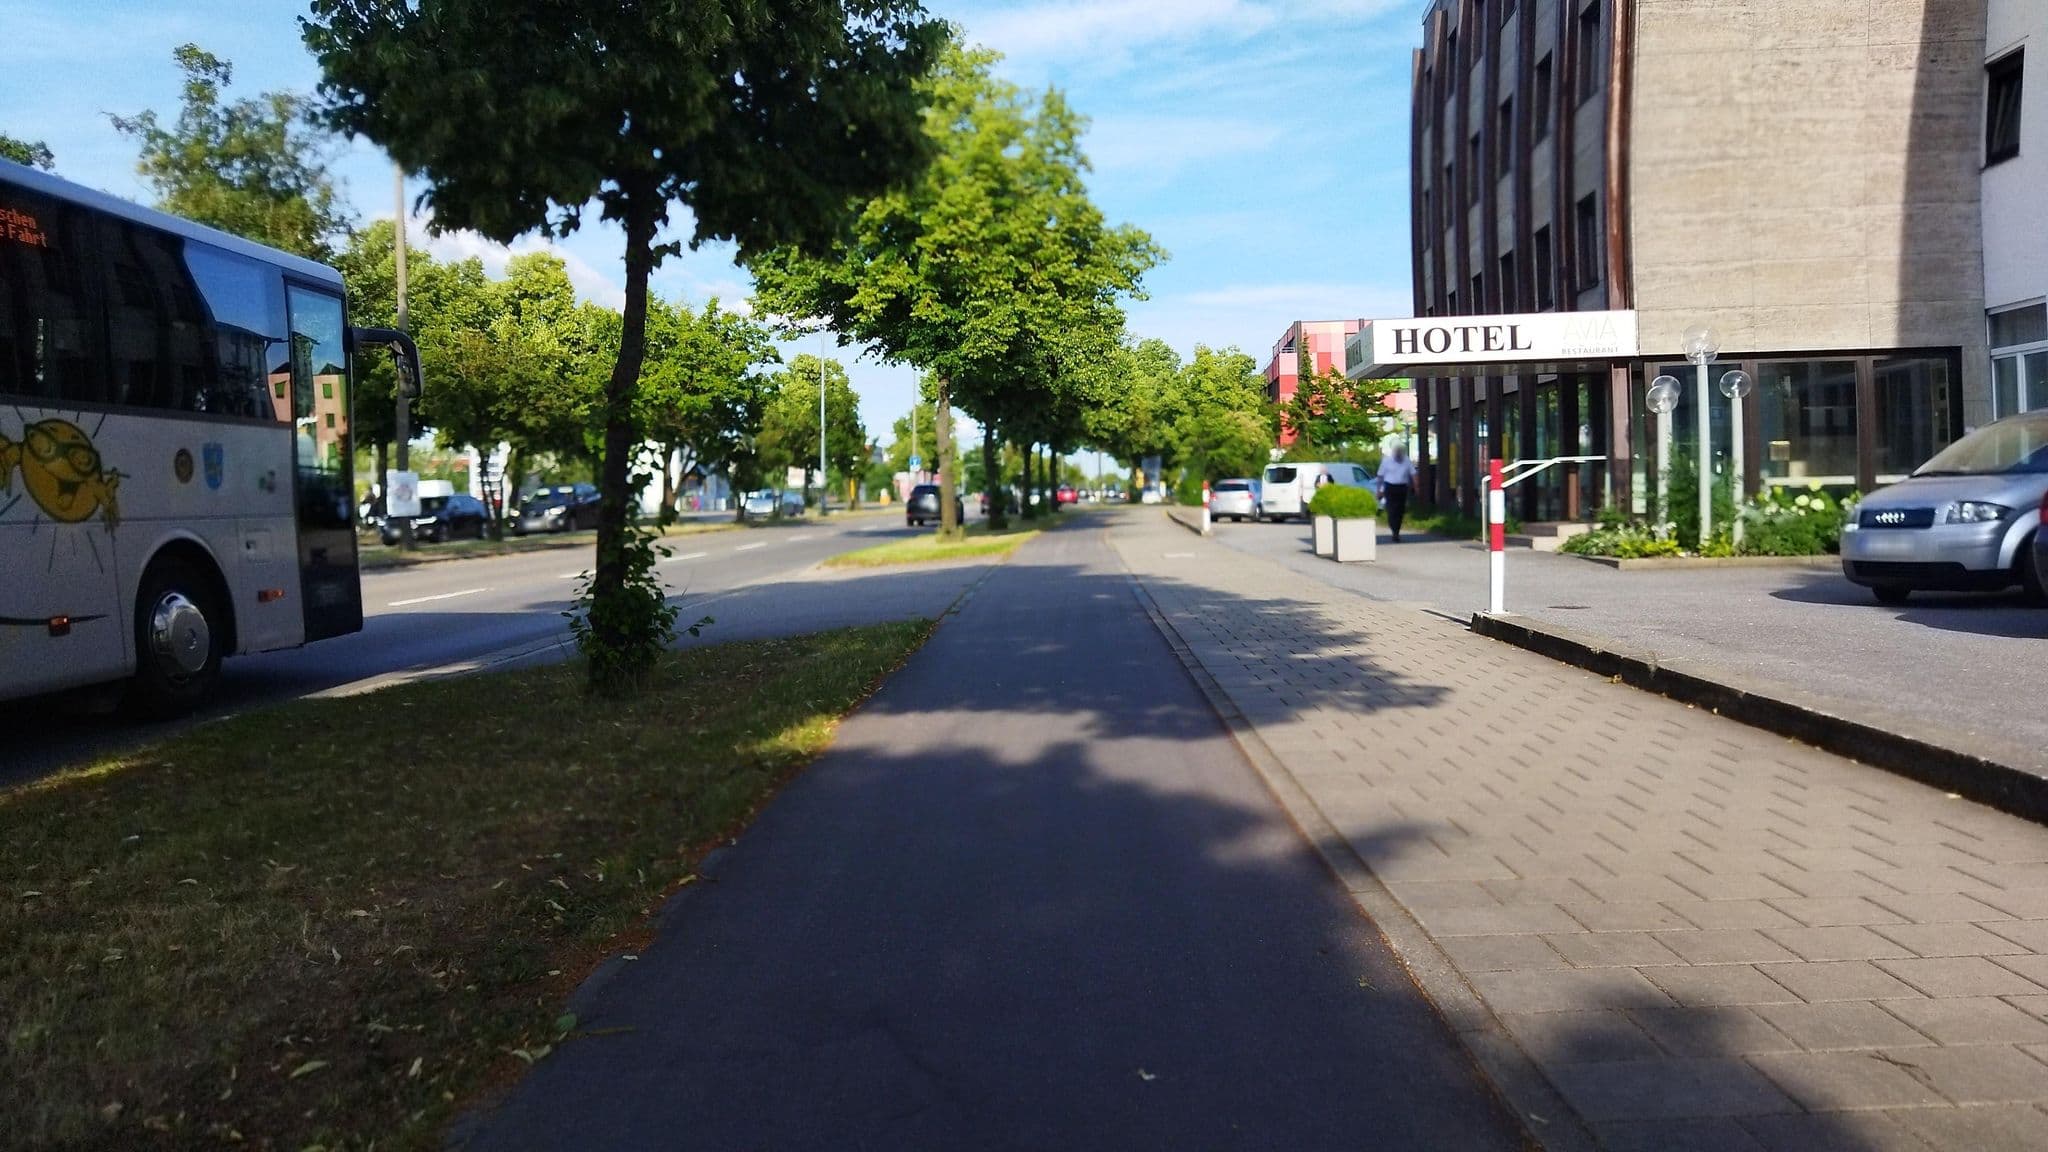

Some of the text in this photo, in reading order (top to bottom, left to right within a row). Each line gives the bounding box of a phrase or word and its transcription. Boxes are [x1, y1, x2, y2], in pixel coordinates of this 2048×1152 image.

[8, 224, 47, 247] Fahrt
[1392, 324, 1532, 354] HOTEL
[1561, 346, 1618, 355] RESTAURANT
